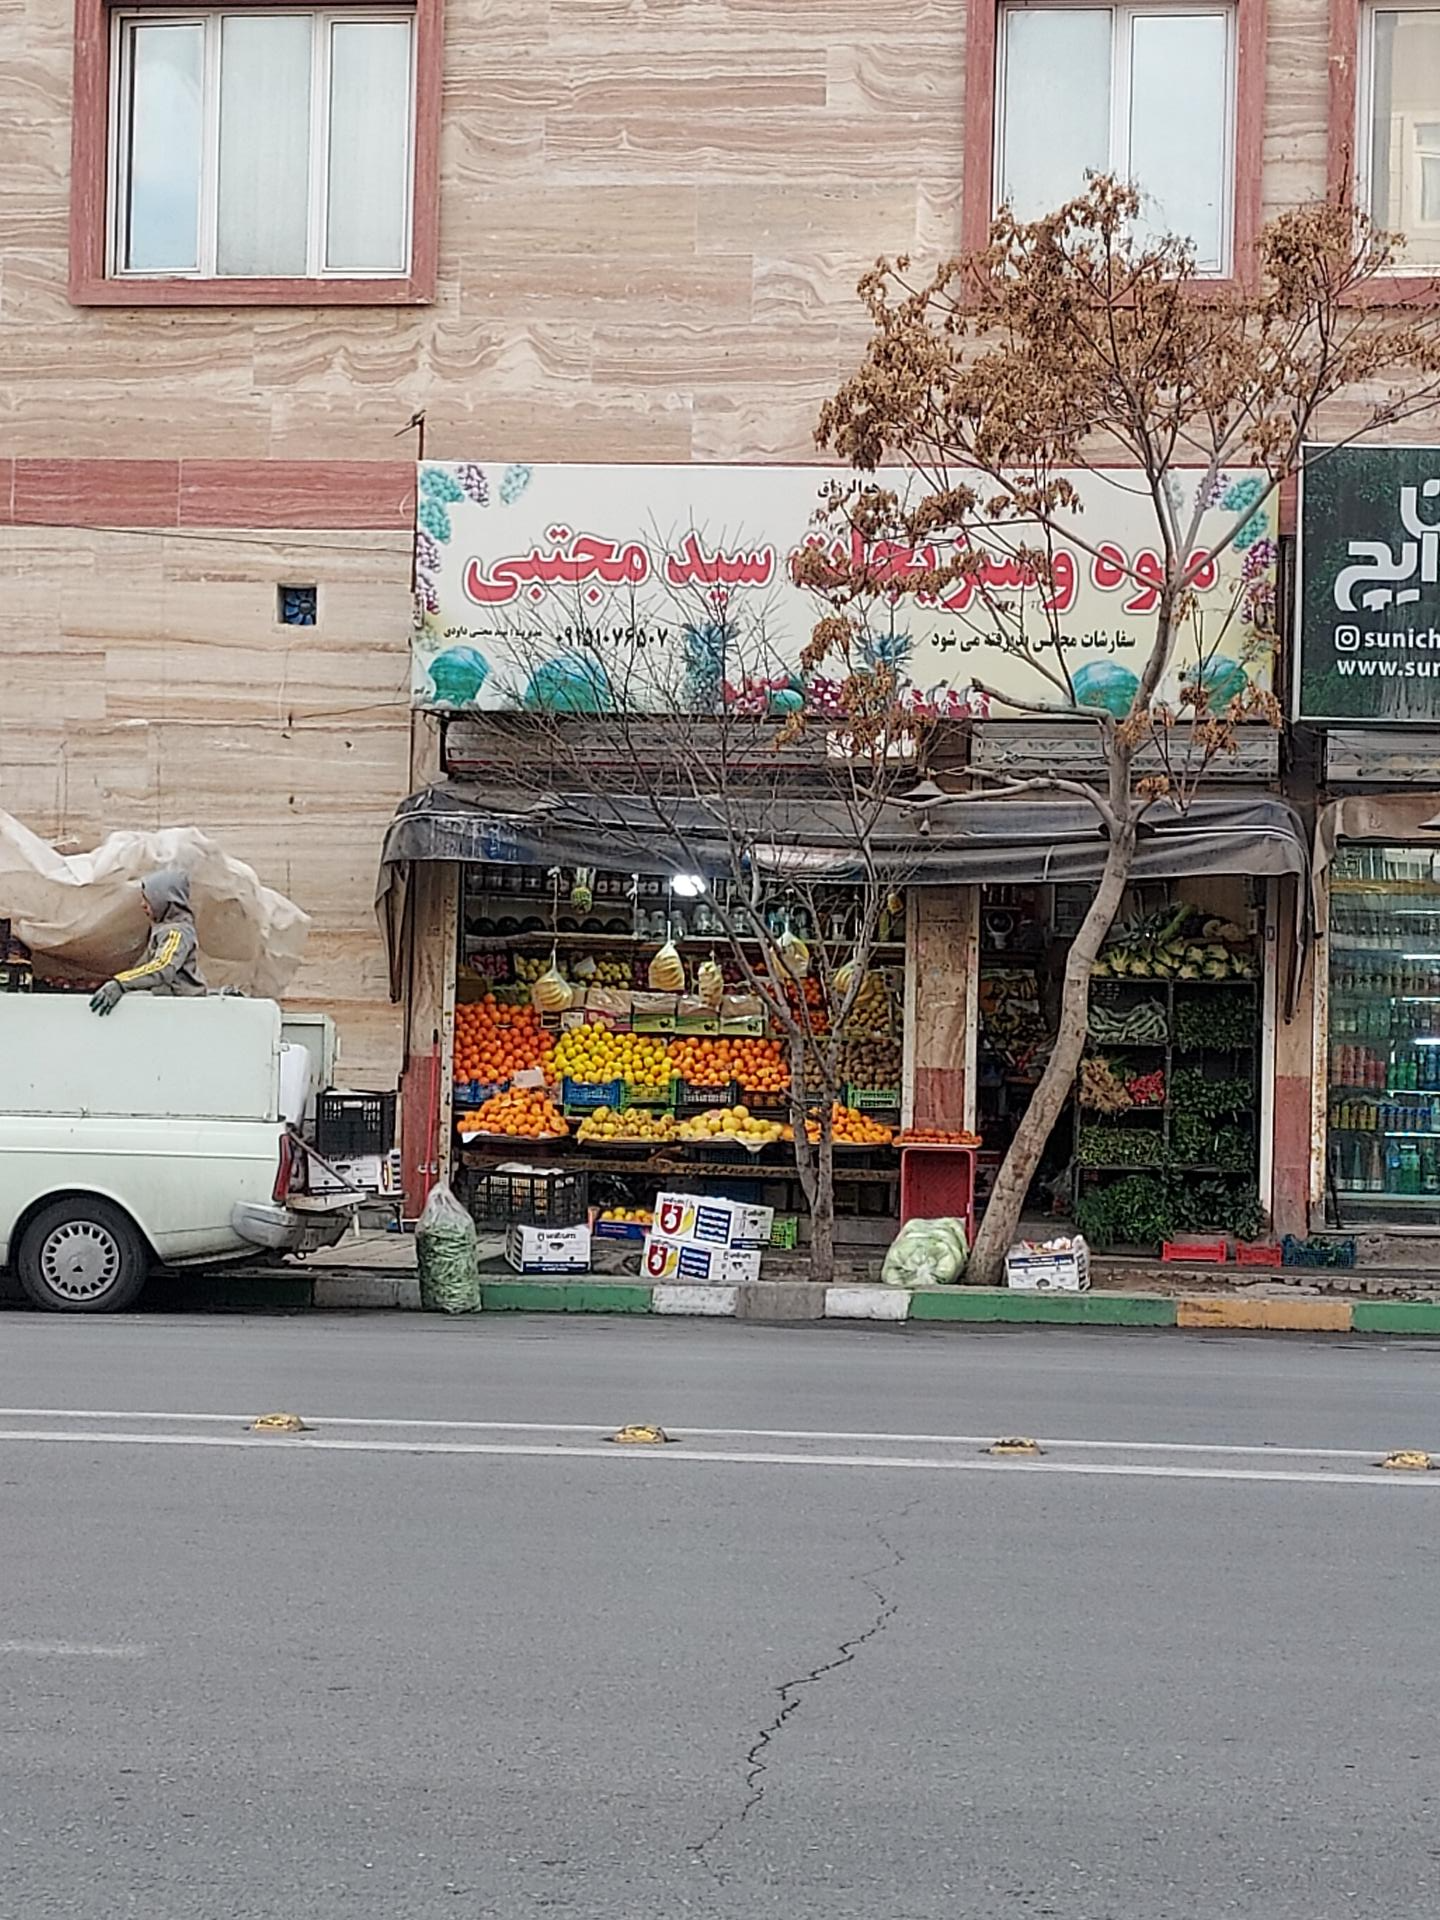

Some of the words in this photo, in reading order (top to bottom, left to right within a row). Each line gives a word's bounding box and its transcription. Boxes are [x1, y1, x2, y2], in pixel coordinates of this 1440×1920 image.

[464, 525, 652, 605] مجتبی
[664, 530, 775, 604] سید
[1093, 542, 1218, 612] موه
[931, 629, 957, 653] شود
[961, 636, 981, 653] می
[1032, 630, 1077, 653] مجس
[1081, 629, 1136, 653] سفارشات
[1364, 628, 1440, 649] sunich
